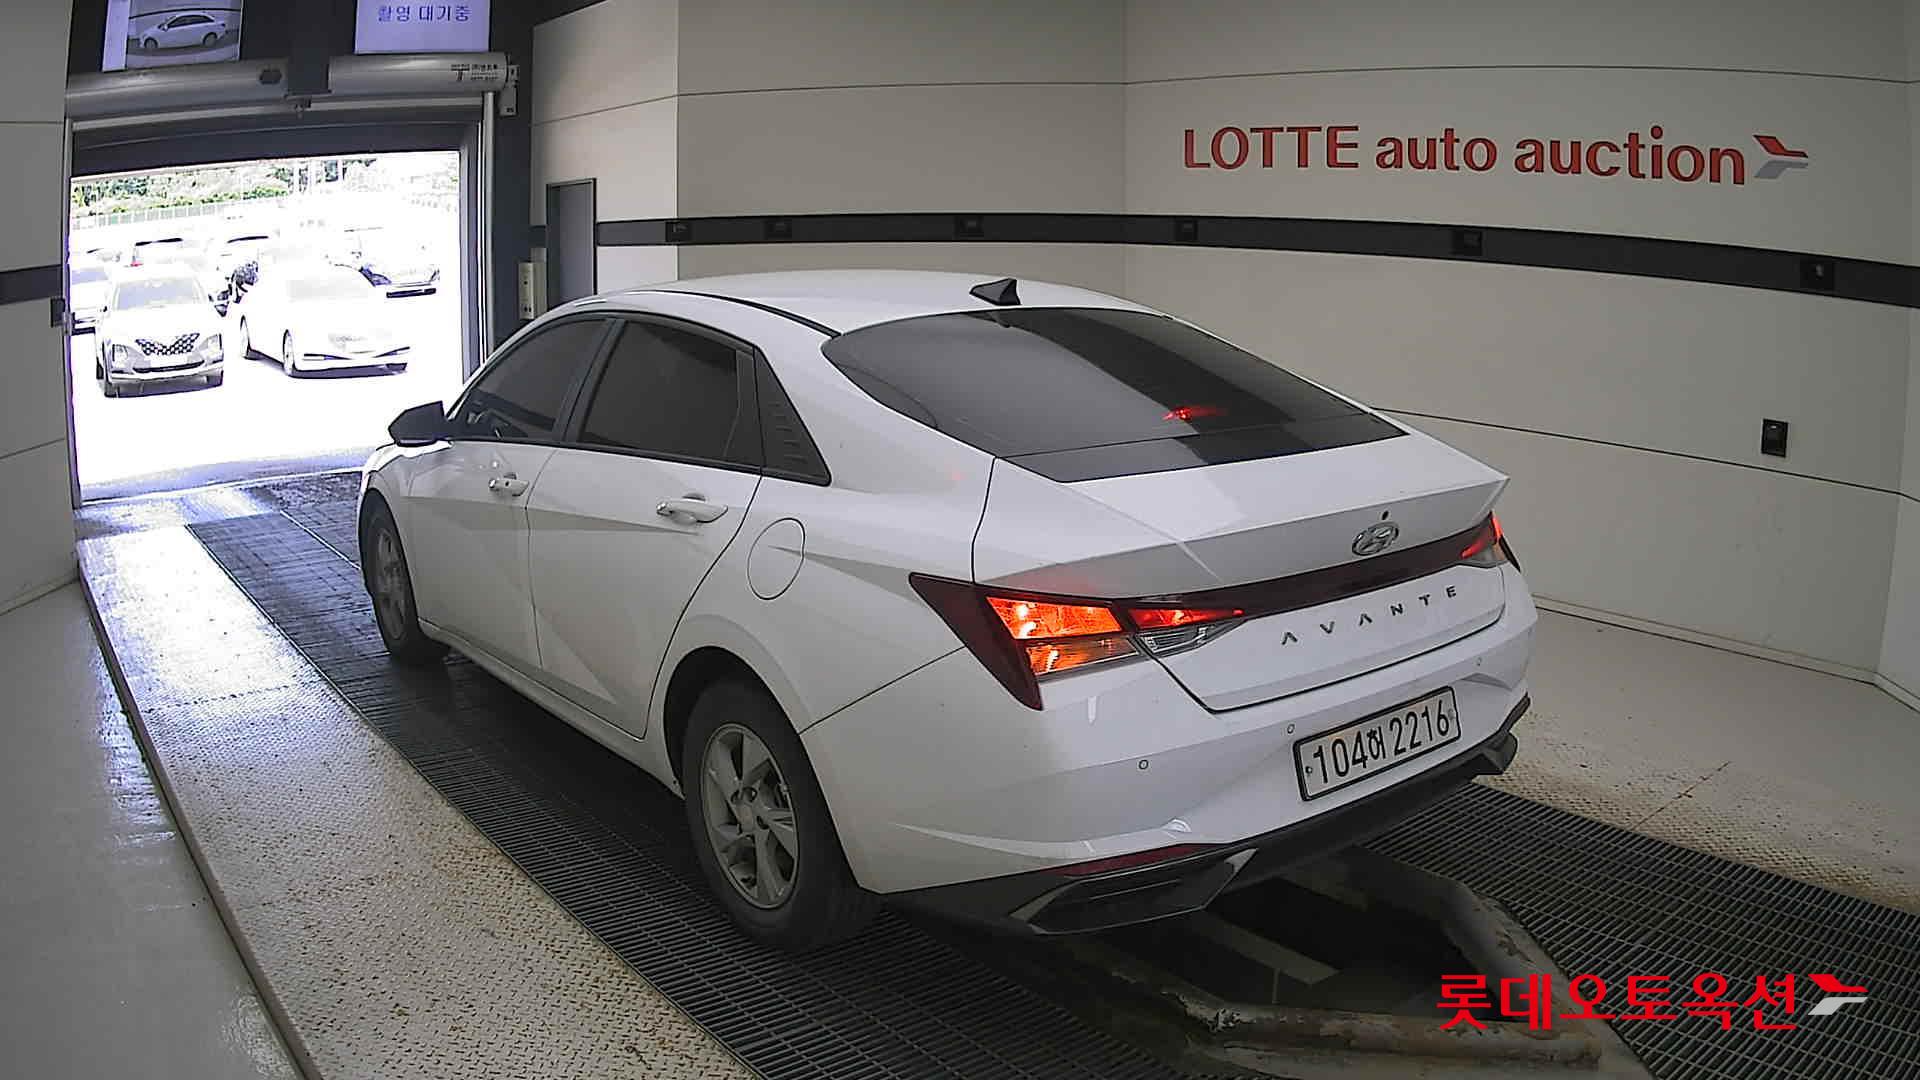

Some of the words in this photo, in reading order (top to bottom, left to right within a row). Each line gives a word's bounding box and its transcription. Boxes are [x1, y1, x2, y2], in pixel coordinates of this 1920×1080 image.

[419, 5, 472, 22] 대기중
[1184, 126, 1358, 169] LOTTE
[1375, 127, 1497, 171] auto
[1514, 126, 1745, 184] auction
[1281, 585, 1457, 645] AVANTE
